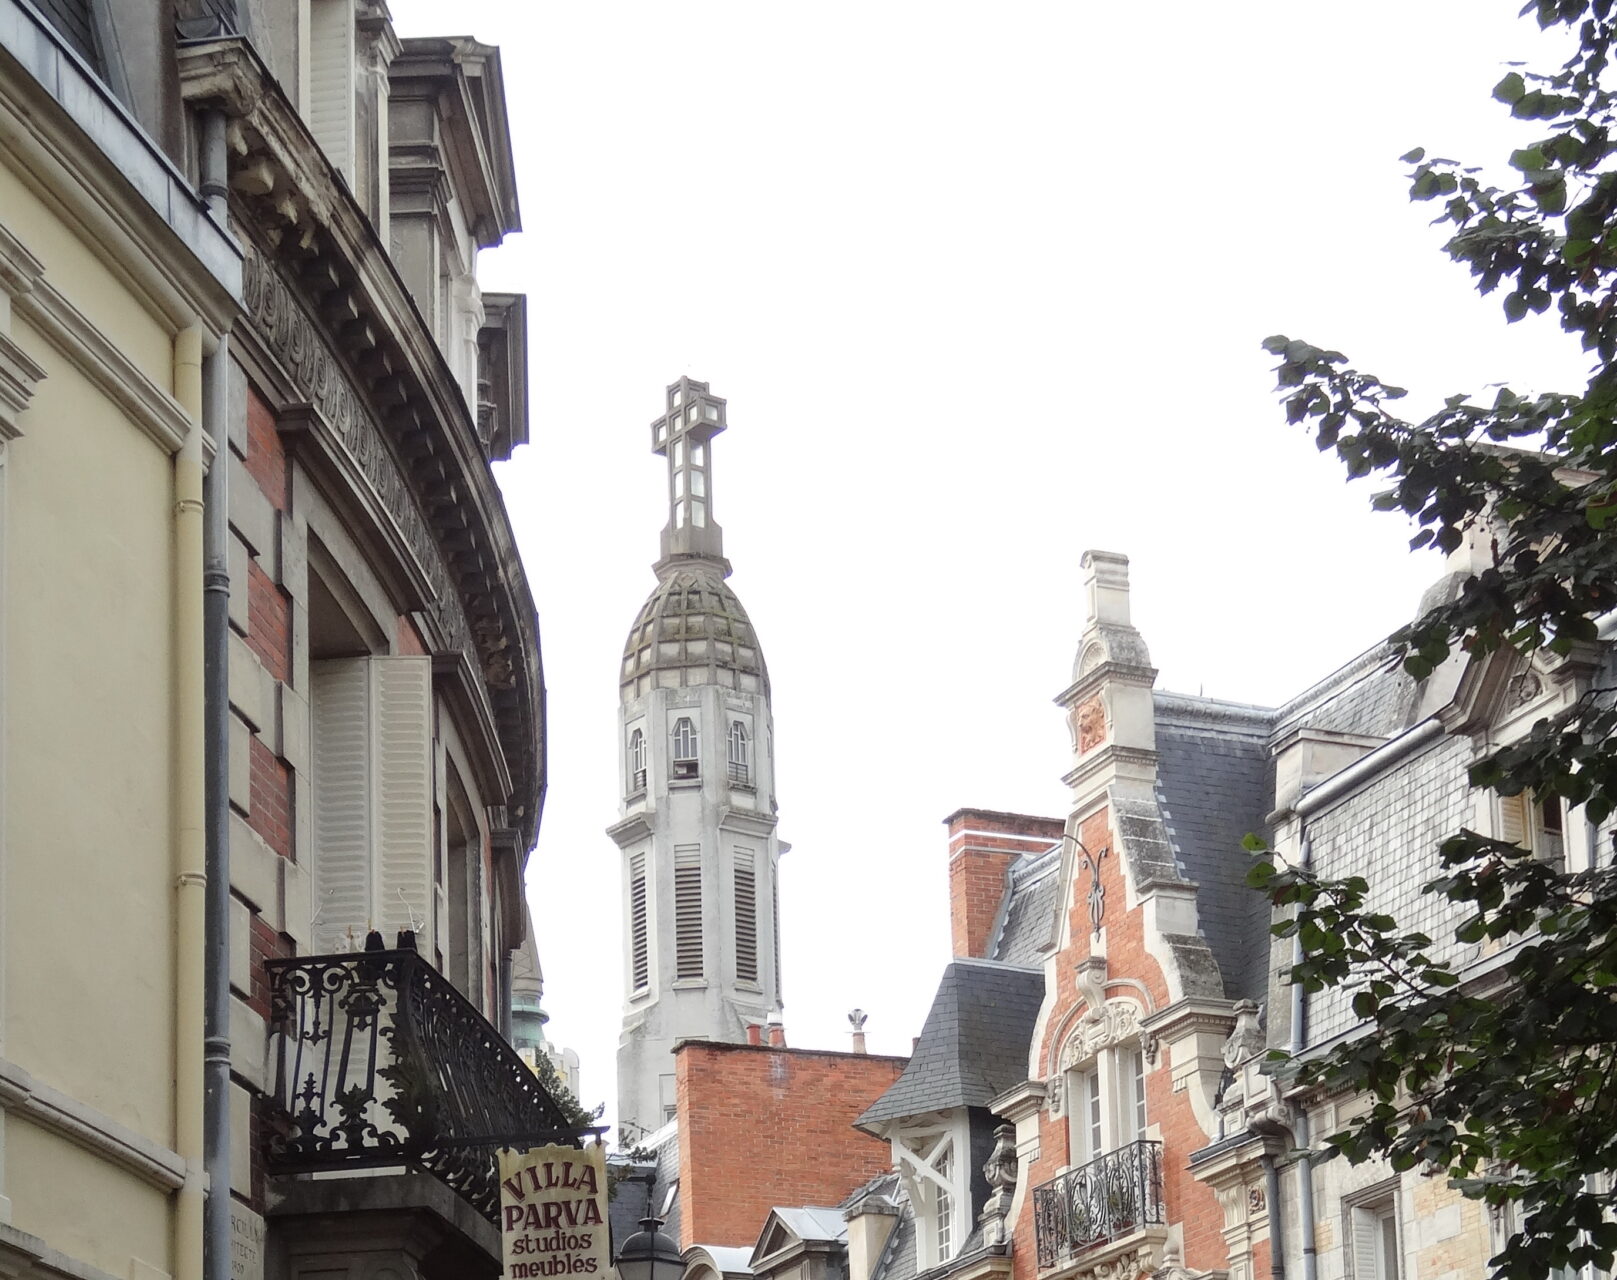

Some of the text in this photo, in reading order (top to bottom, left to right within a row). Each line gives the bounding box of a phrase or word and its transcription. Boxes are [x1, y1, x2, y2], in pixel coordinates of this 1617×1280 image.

[502, 1161, 599, 1204] VILLA
[504, 1197, 604, 1232] PARVA
[510, 1230, 593, 1256] studios
[510, 1252, 598, 1280] meublés
